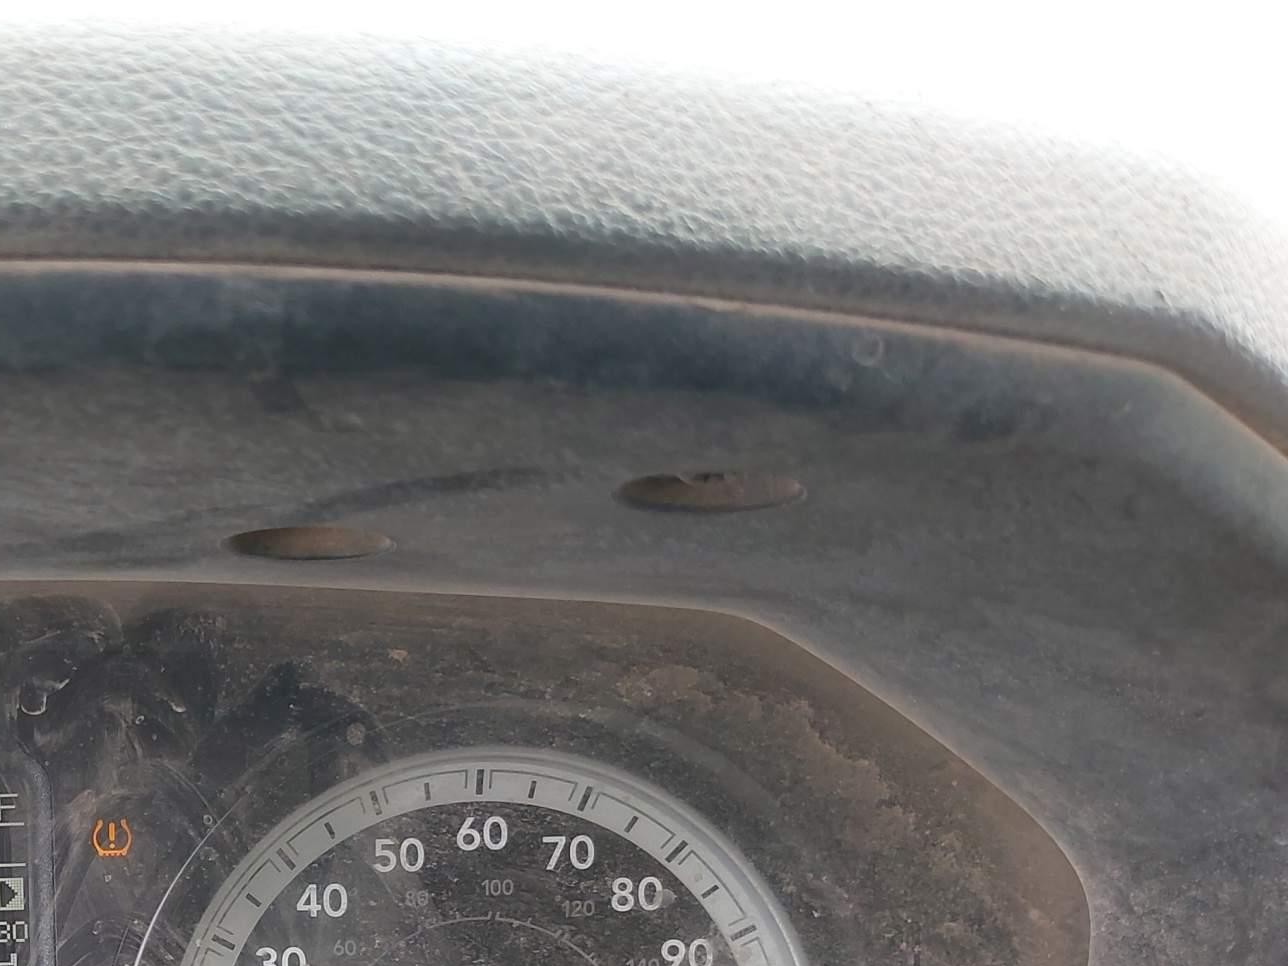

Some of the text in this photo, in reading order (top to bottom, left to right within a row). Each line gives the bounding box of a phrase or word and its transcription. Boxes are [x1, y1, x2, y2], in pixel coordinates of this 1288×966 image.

[456, 817, 507, 851] 60
[374, 838, 424, 873] 50
[542, 835, 594, 870] 70
[296, 883, 348, 918] 40
[482, 880, 513, 896] 100
[611, 876, 663, 911] 80
[564, 900, 594, 917] 120
[333, 940, 356, 957] 60
